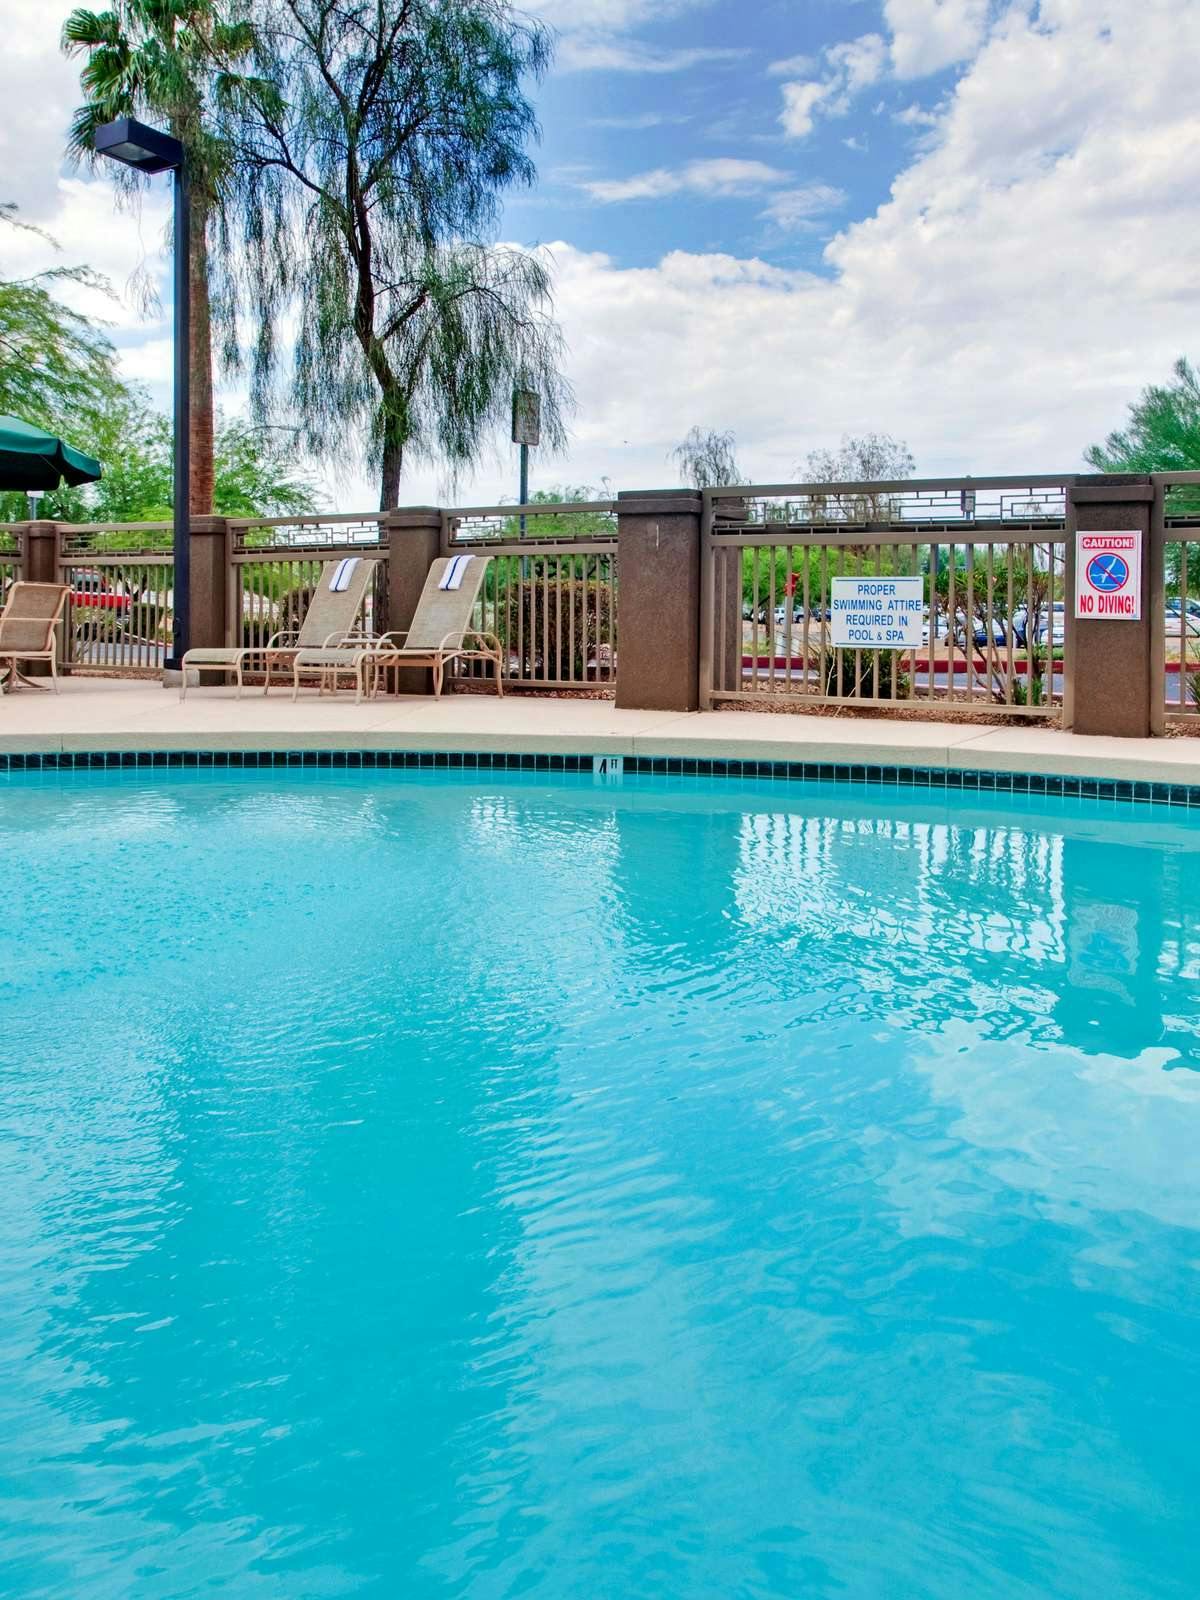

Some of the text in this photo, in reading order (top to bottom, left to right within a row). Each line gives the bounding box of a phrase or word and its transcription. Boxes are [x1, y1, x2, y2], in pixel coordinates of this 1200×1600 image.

[1083, 538, 1133, 548] CAUTION!
[857, 584, 896, 596] PROPER
[833, 599, 922, 611] SWIMMING ATTIRE
[1080, 595, 1135, 614] NO DIVING!
[846, 614, 908, 626] REQUIRED IN
[848, 629, 905, 641] POOL & SPA
